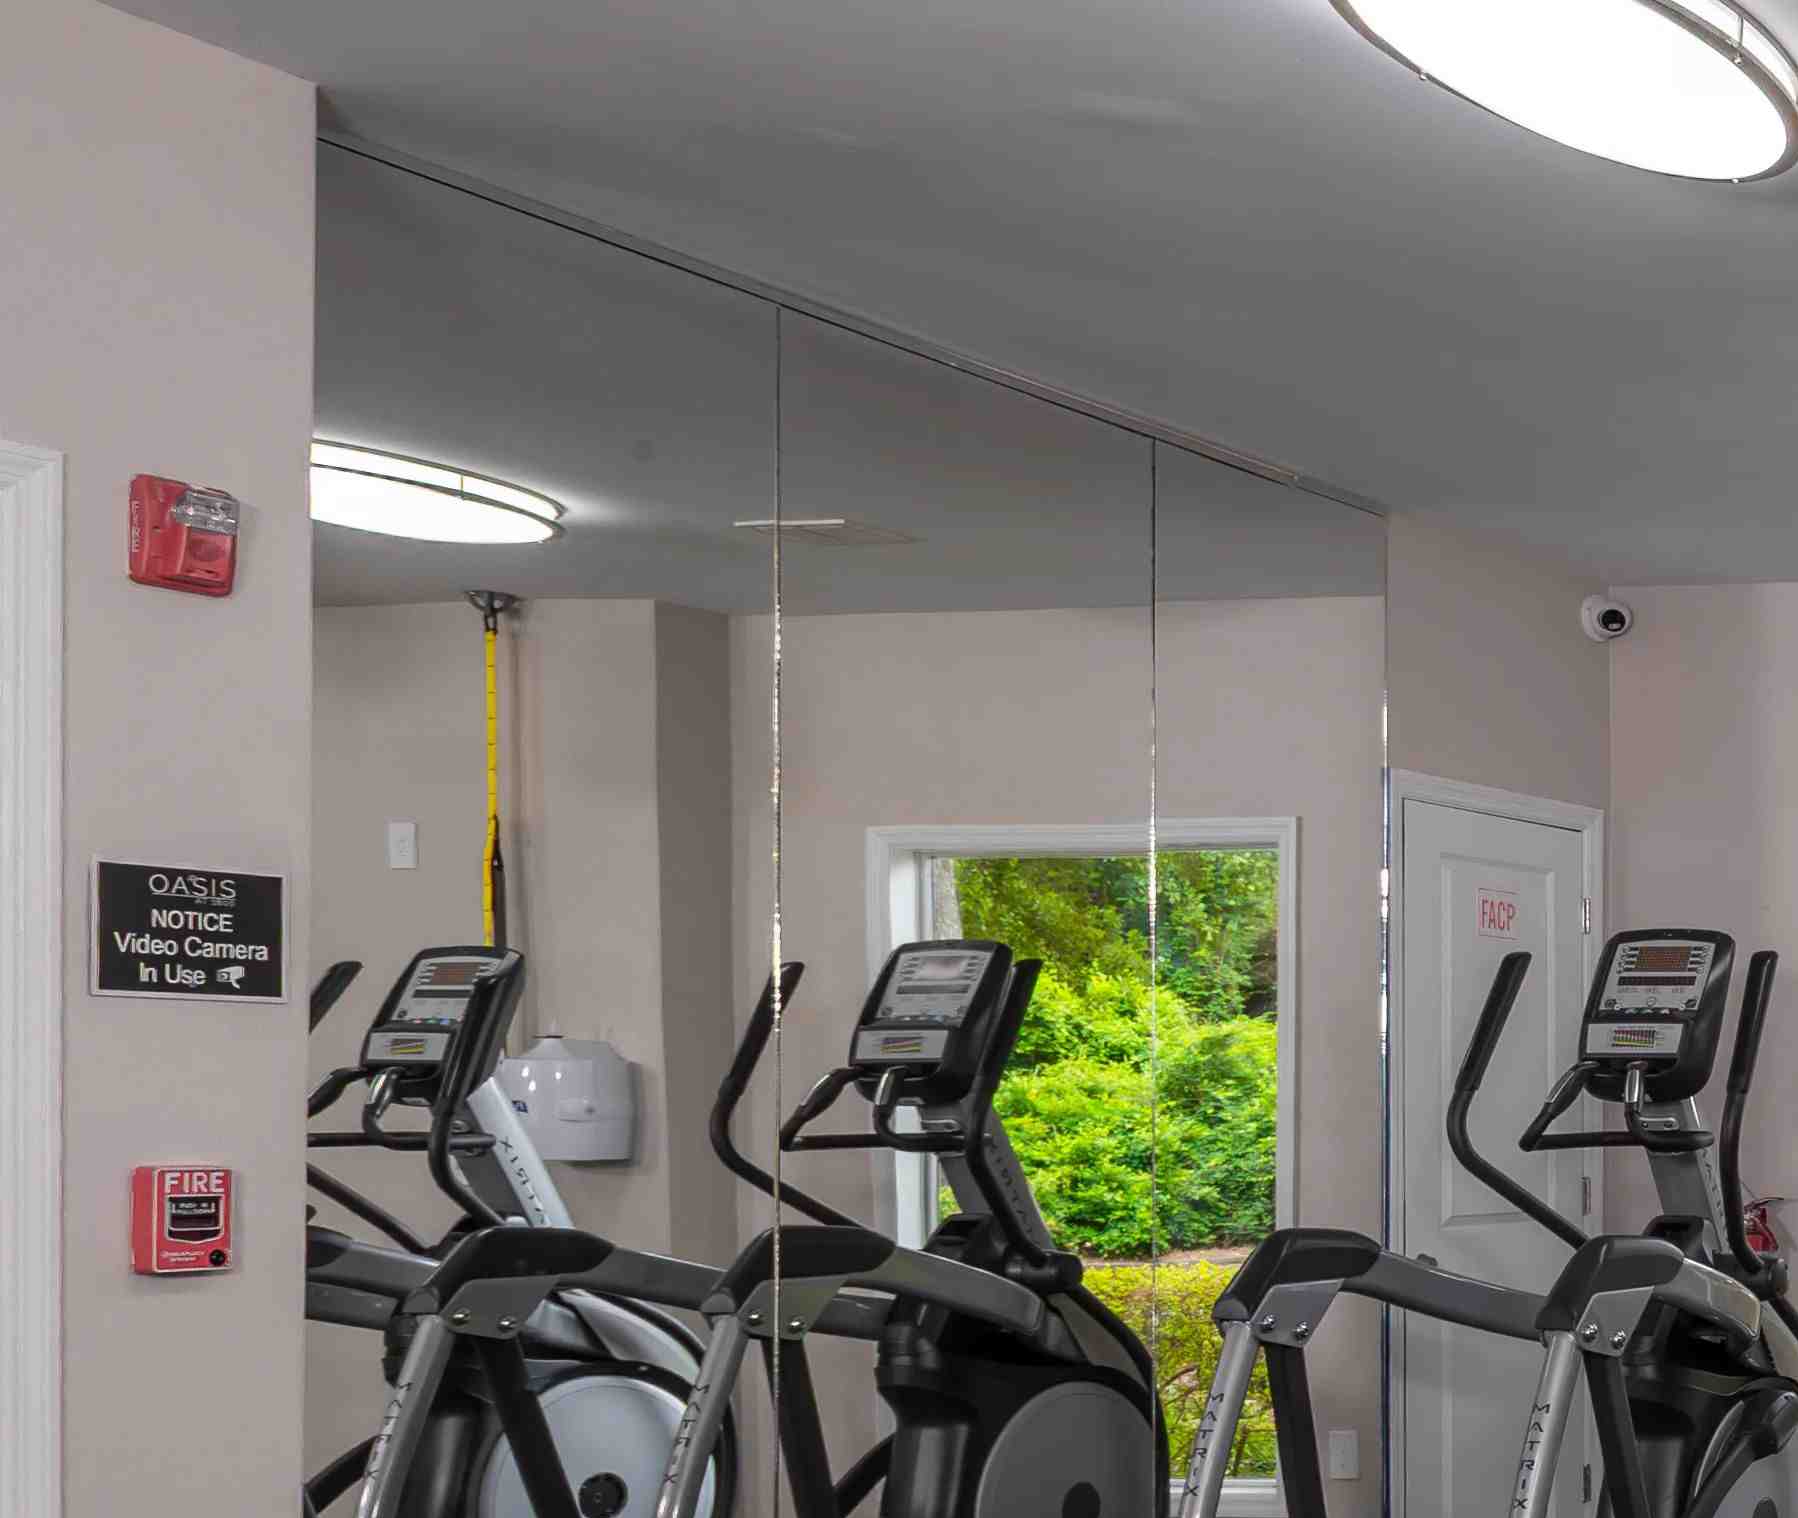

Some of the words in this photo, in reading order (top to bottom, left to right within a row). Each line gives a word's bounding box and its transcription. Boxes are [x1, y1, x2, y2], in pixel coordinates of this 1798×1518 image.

[149, 873, 236, 899] OASIS
[151, 908, 233, 932] NOTICE
[1482, 899, 1515, 930] FACP
[113, 931, 179, 956] Video
[184, 936, 269, 961] Camera
[139, 962, 158, 983] In
[165, 963, 207, 985] Use
[165, 1171, 225, 1193] FIRE
[1182, 1392, 1225, 1497] MATRIX
[1512, 1403, 1551, 1510] MATRIX
